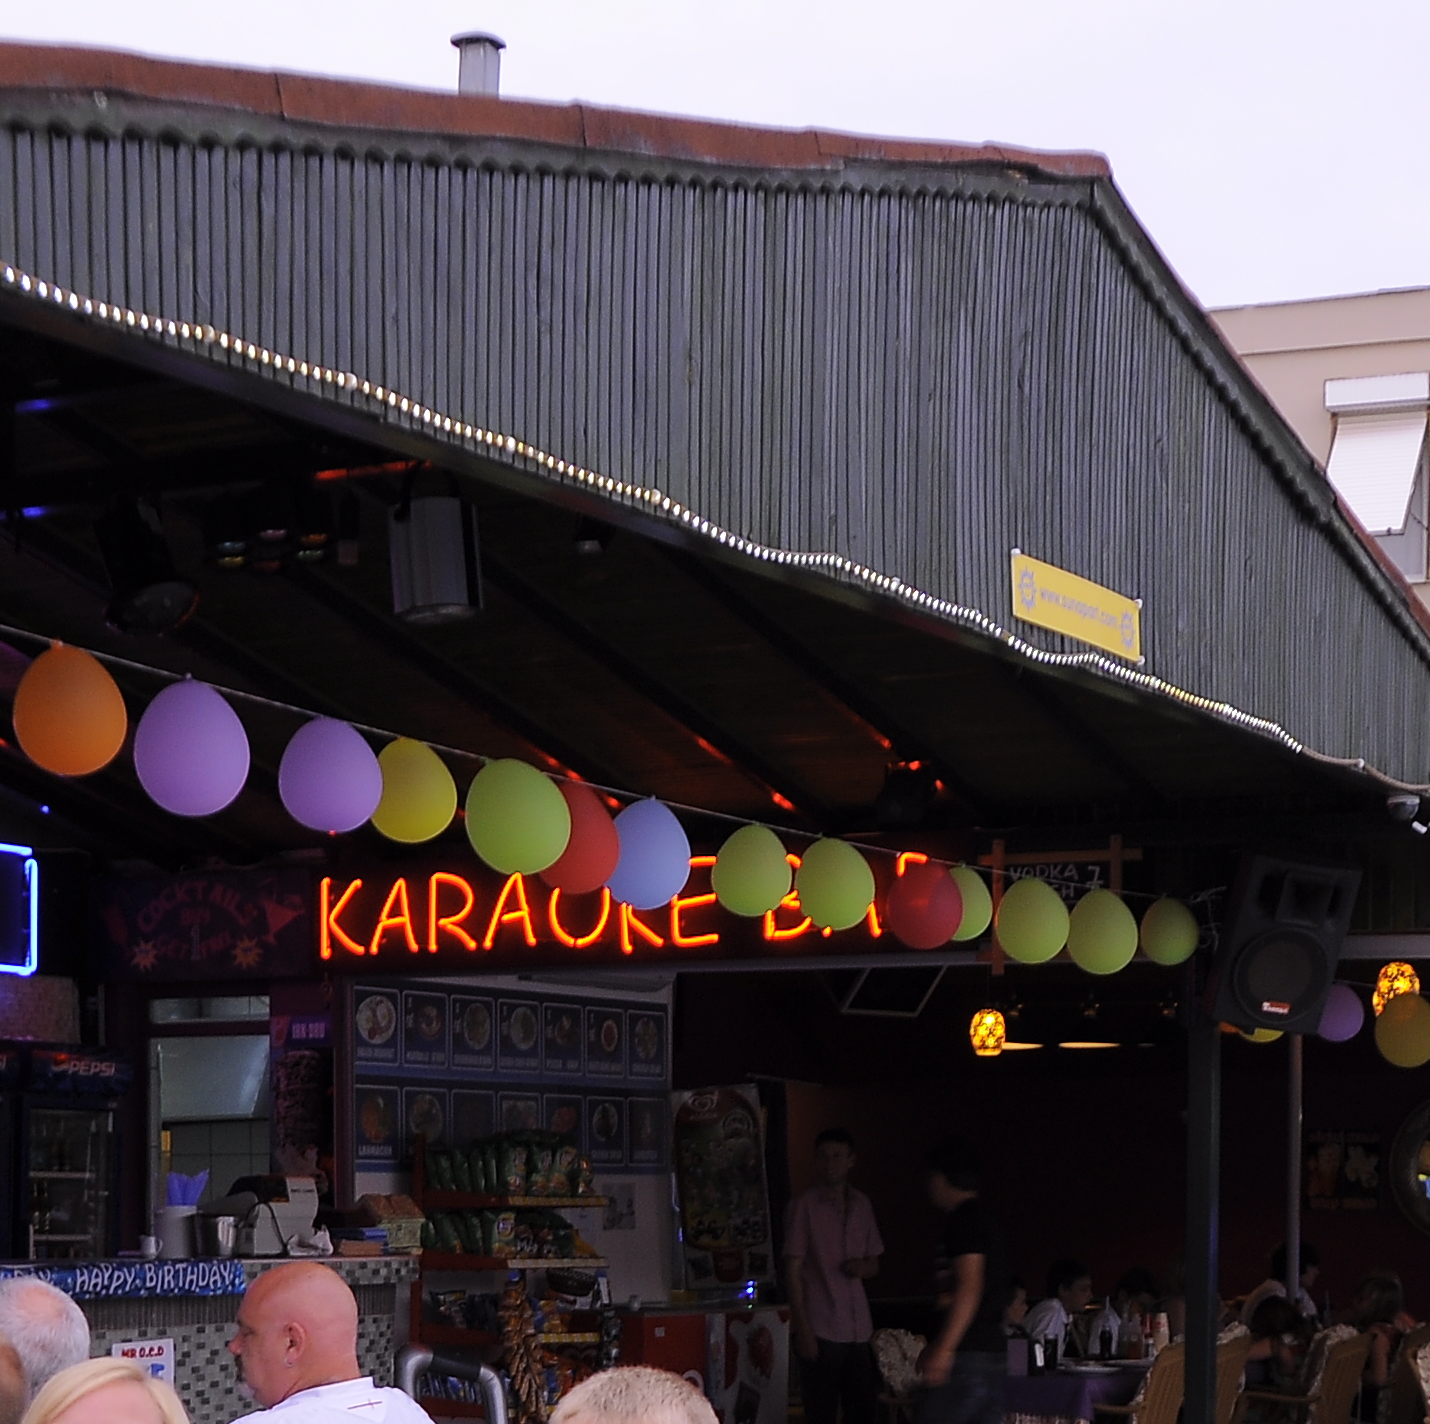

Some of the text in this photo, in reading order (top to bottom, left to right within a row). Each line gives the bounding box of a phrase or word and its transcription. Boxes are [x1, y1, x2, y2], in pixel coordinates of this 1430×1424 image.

[1008, 863, 1079, 882] VODKA
[69, 1060, 117, 1077] PEPSI
[74, 1261, 233, 1295] HAPPY BIRTHDAY
